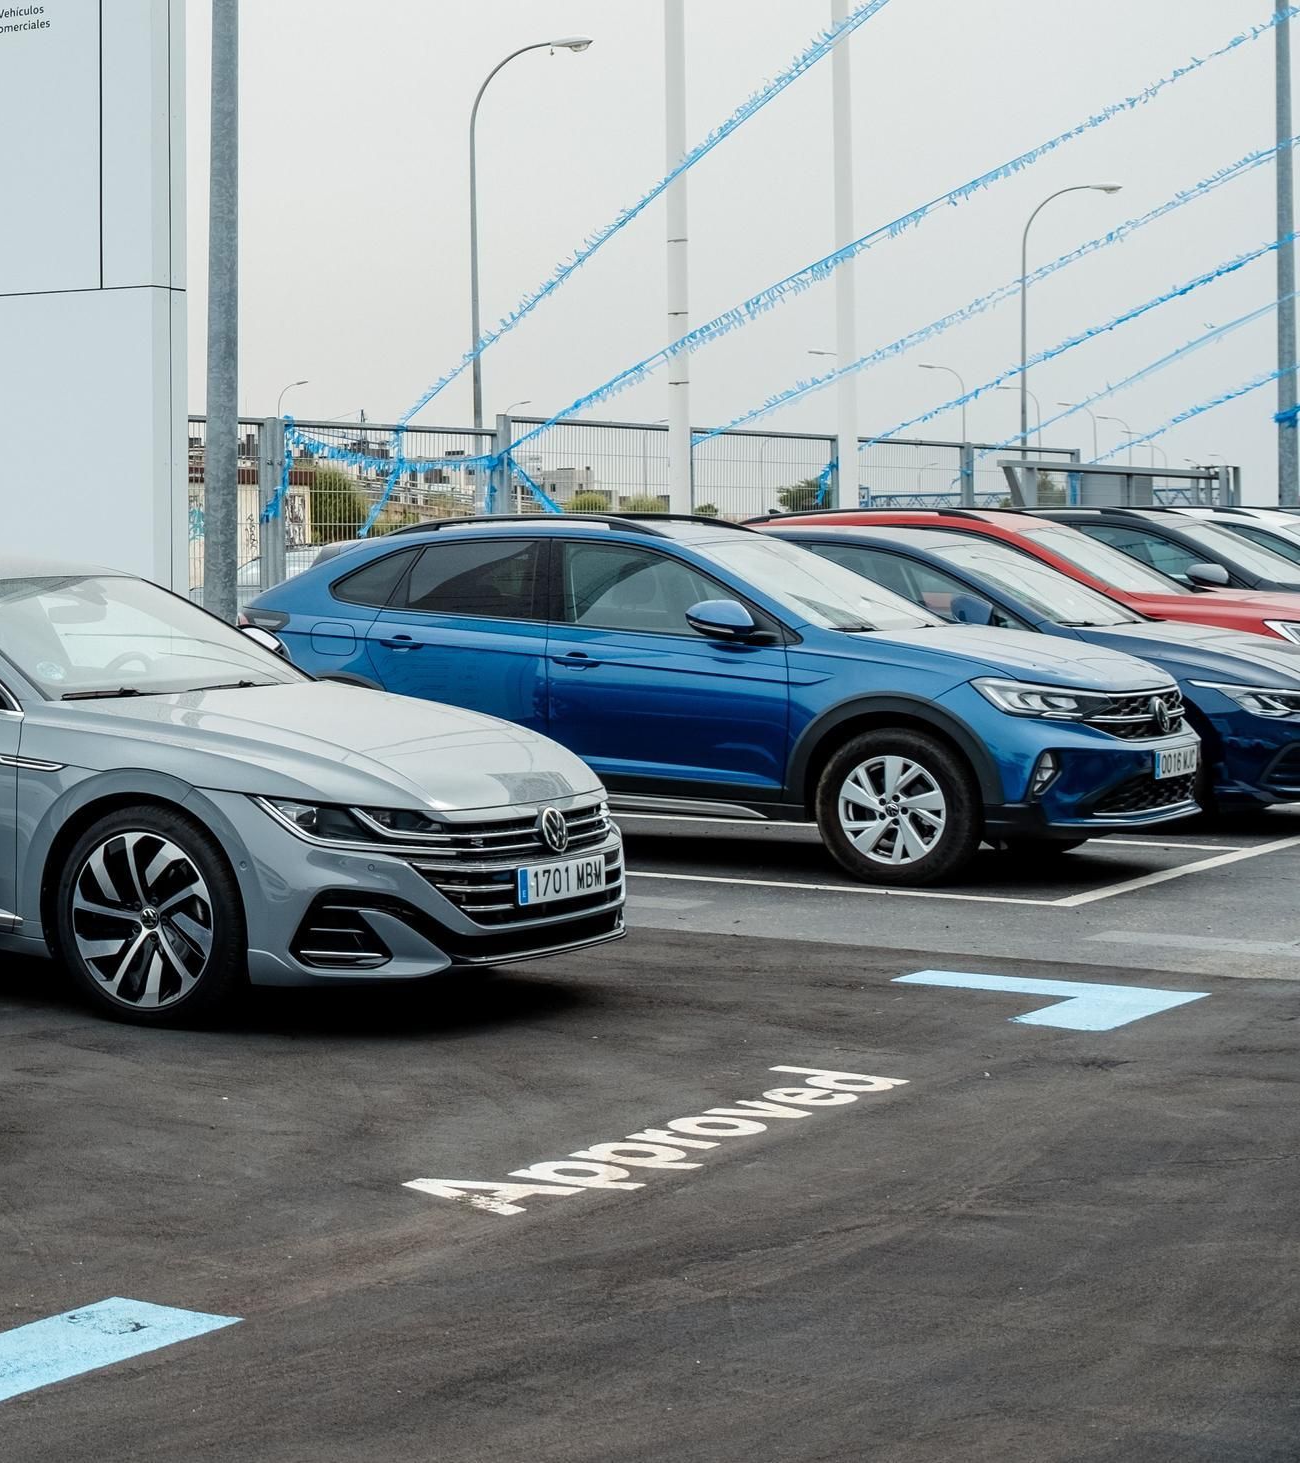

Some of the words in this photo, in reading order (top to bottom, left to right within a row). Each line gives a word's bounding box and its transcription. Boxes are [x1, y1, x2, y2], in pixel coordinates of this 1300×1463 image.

[1162, 752, 1182, 774] 0016
[533, 865, 570, 898] 1701
[576, 860, 602, 890] MBM
[401, 1065, 910, 1216] Approved
